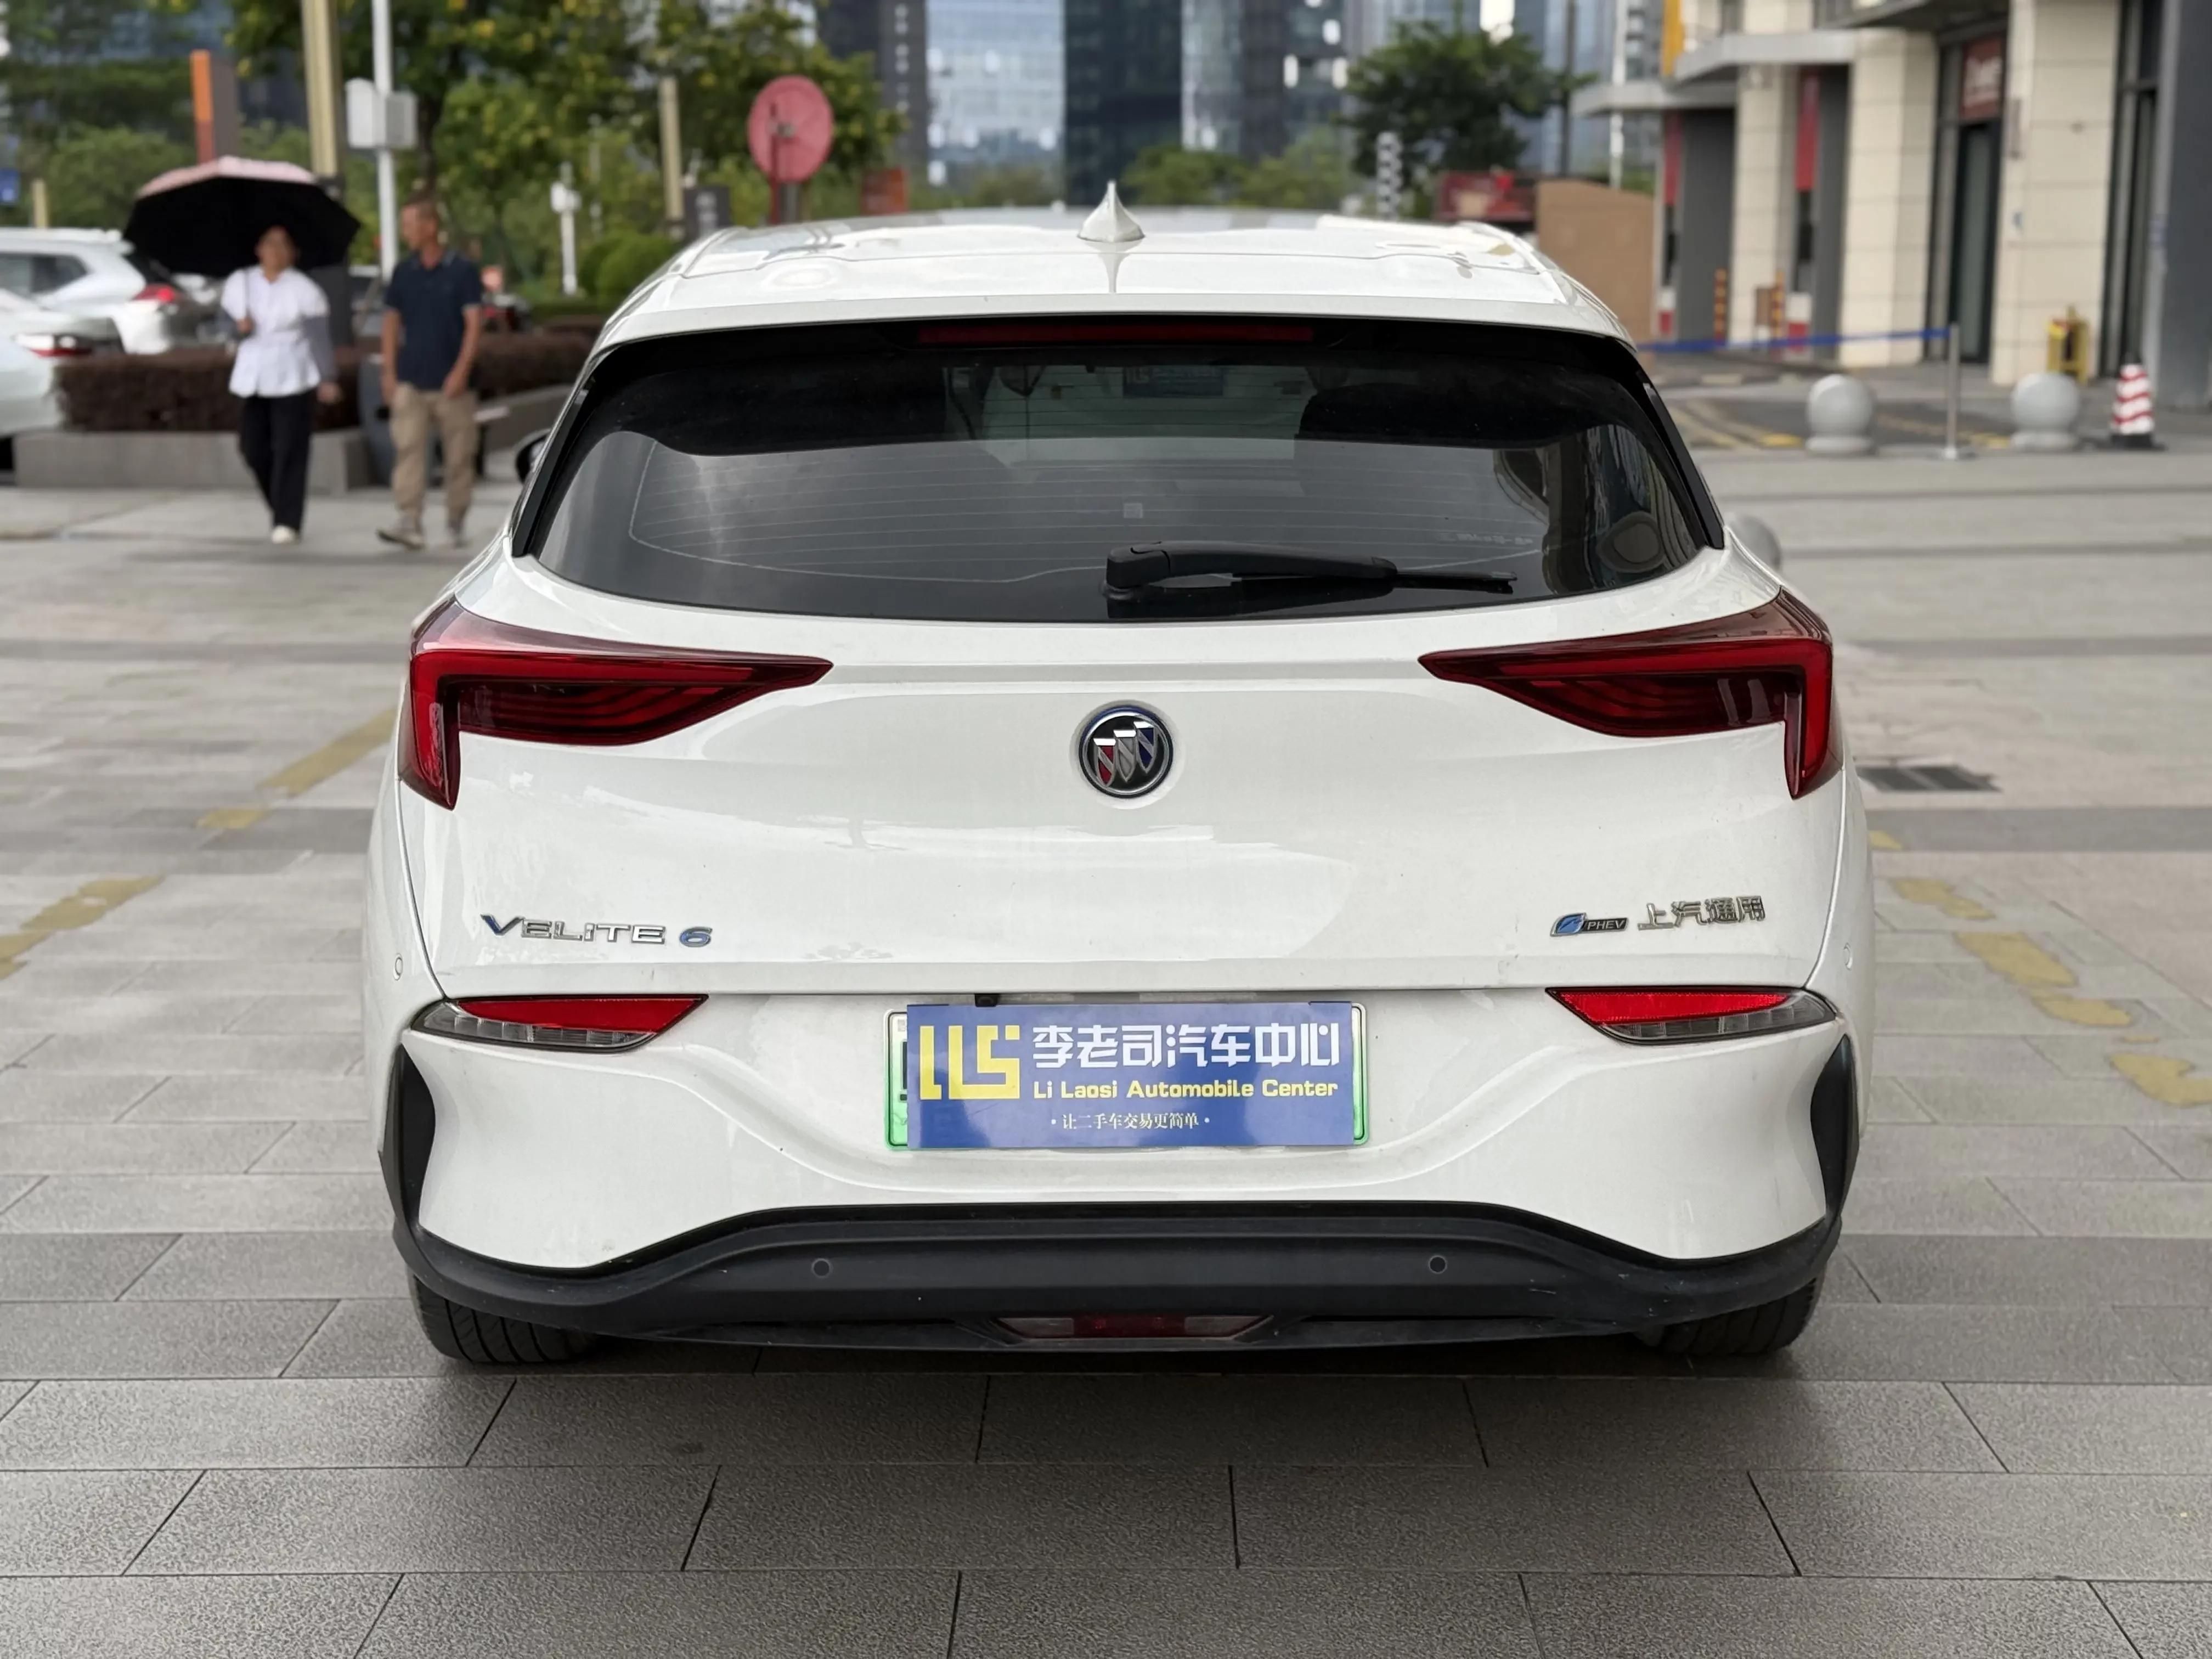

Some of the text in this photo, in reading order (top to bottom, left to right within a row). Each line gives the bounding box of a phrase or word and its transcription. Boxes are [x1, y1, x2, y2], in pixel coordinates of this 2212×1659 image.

[1586, 919, 1626, 931] PHEV
[1637, 895, 1767, 932] 上汽通用
[480, 913, 713, 948] VELITE 6
[1032, 1022, 1340, 1068] 李老司汽车中心
[1034, 1079, 1339, 1099] Li Laosi Automobile Center
[1062, 1112, 1199, 1130] 让二手车交易更简单
